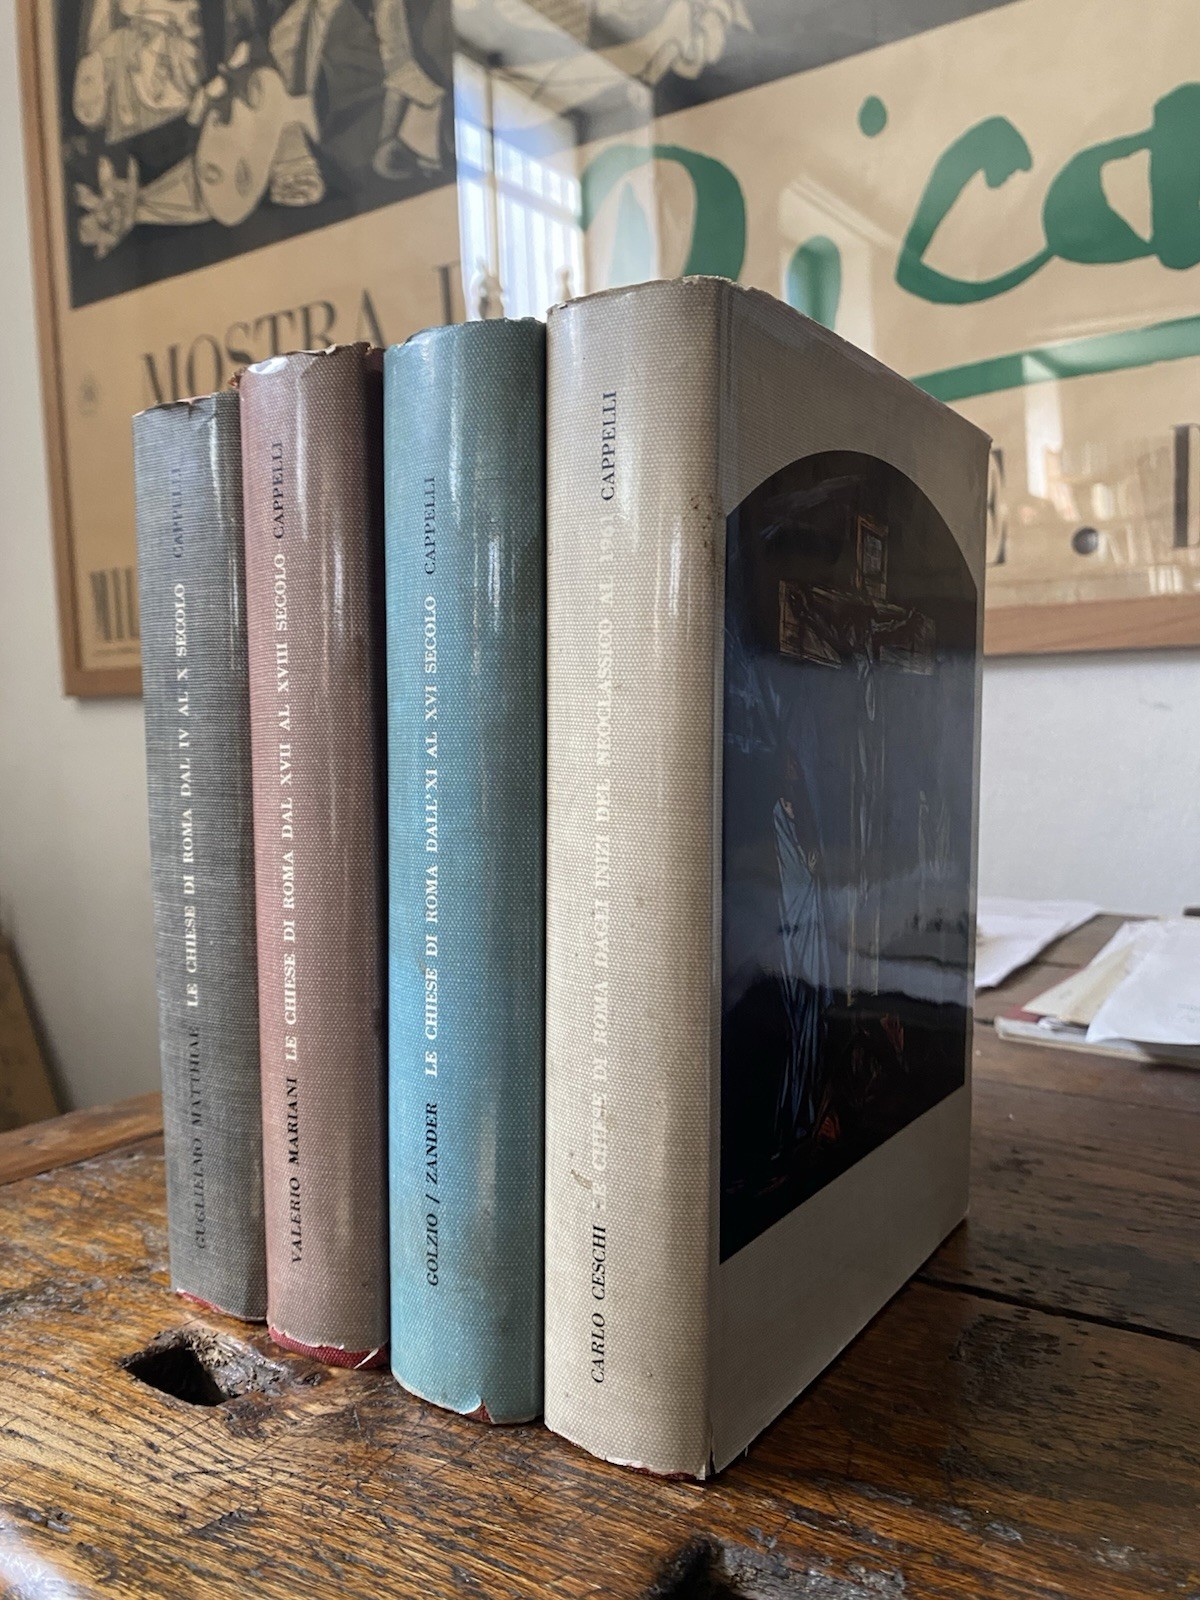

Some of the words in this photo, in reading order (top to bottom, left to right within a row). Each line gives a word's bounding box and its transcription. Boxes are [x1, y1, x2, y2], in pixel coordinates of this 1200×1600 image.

[143, 288, 386, 402] MOSTRA
[600, 391, 617, 501] CAPPELLI
[170, 467, 184, 558] CAPPELLI
[272, 441, 285, 539] CAPPELLI
[423, 476, 436, 575] CAPPELLI
[173, 583, 188, 657] SECOLO
[274, 554, 287, 631] SECOLO
[599, 572, 613, 606] AL
[424, 596, 437, 674] SECOLO
[177, 667, 188, 680] X
[277, 643, 289, 692] XVIII
[597, 619, 613, 765] NEOCLASSICO
[177, 692, 189, 716] AL
[277, 704, 290, 730] AL
[425, 686, 438, 721] XVI
[179, 729, 190, 747] IV
[279, 743, 291, 785] XVII
[425, 732, 438, 758] AL
[179, 758, 191, 796] DAL
[595, 780, 611, 822] DEL
[182, 809, 195, 862] ROMA
[281, 798, 293, 838] DAL
[183, 875, 196, 895] DI
[282, 850, 294, 909] ROMA
[594, 834, 610, 888] INIZI
[426, 865, 439, 923] ROMA
[184, 906, 197, 973] CHIESE
[283, 920, 296, 941] DI
[426, 935, 439, 957] DI
[592, 899, 610, 969] DAGLI
[186, 984, 199, 1006] LE
[284, 954, 297, 1025] CHIESE
[425, 968, 438, 1040] CHIESE
[592, 980, 608, 1045] ROMA
[189, 1027, 203, 1126] MATTHIAE
[285, 1036, 297, 1061] LE
[425, 1051, 438, 1077] LE
[592, 1056, 608, 1081] DI
[286, 1077, 299, 1166] MARIANI
[426, 1103, 439, 1185] ZANDER
[592, 1093, 607, 1172] CHIESE
[192, 1138, 207, 1249] GUGLIELMO
[289, 1177, 302, 1265] VALERIO
[426, 1214, 439, 1286] GOLZIO
[591, 1225, 607, 1301] CESCHI
[590, 1312, 606, 1384] CARLO
